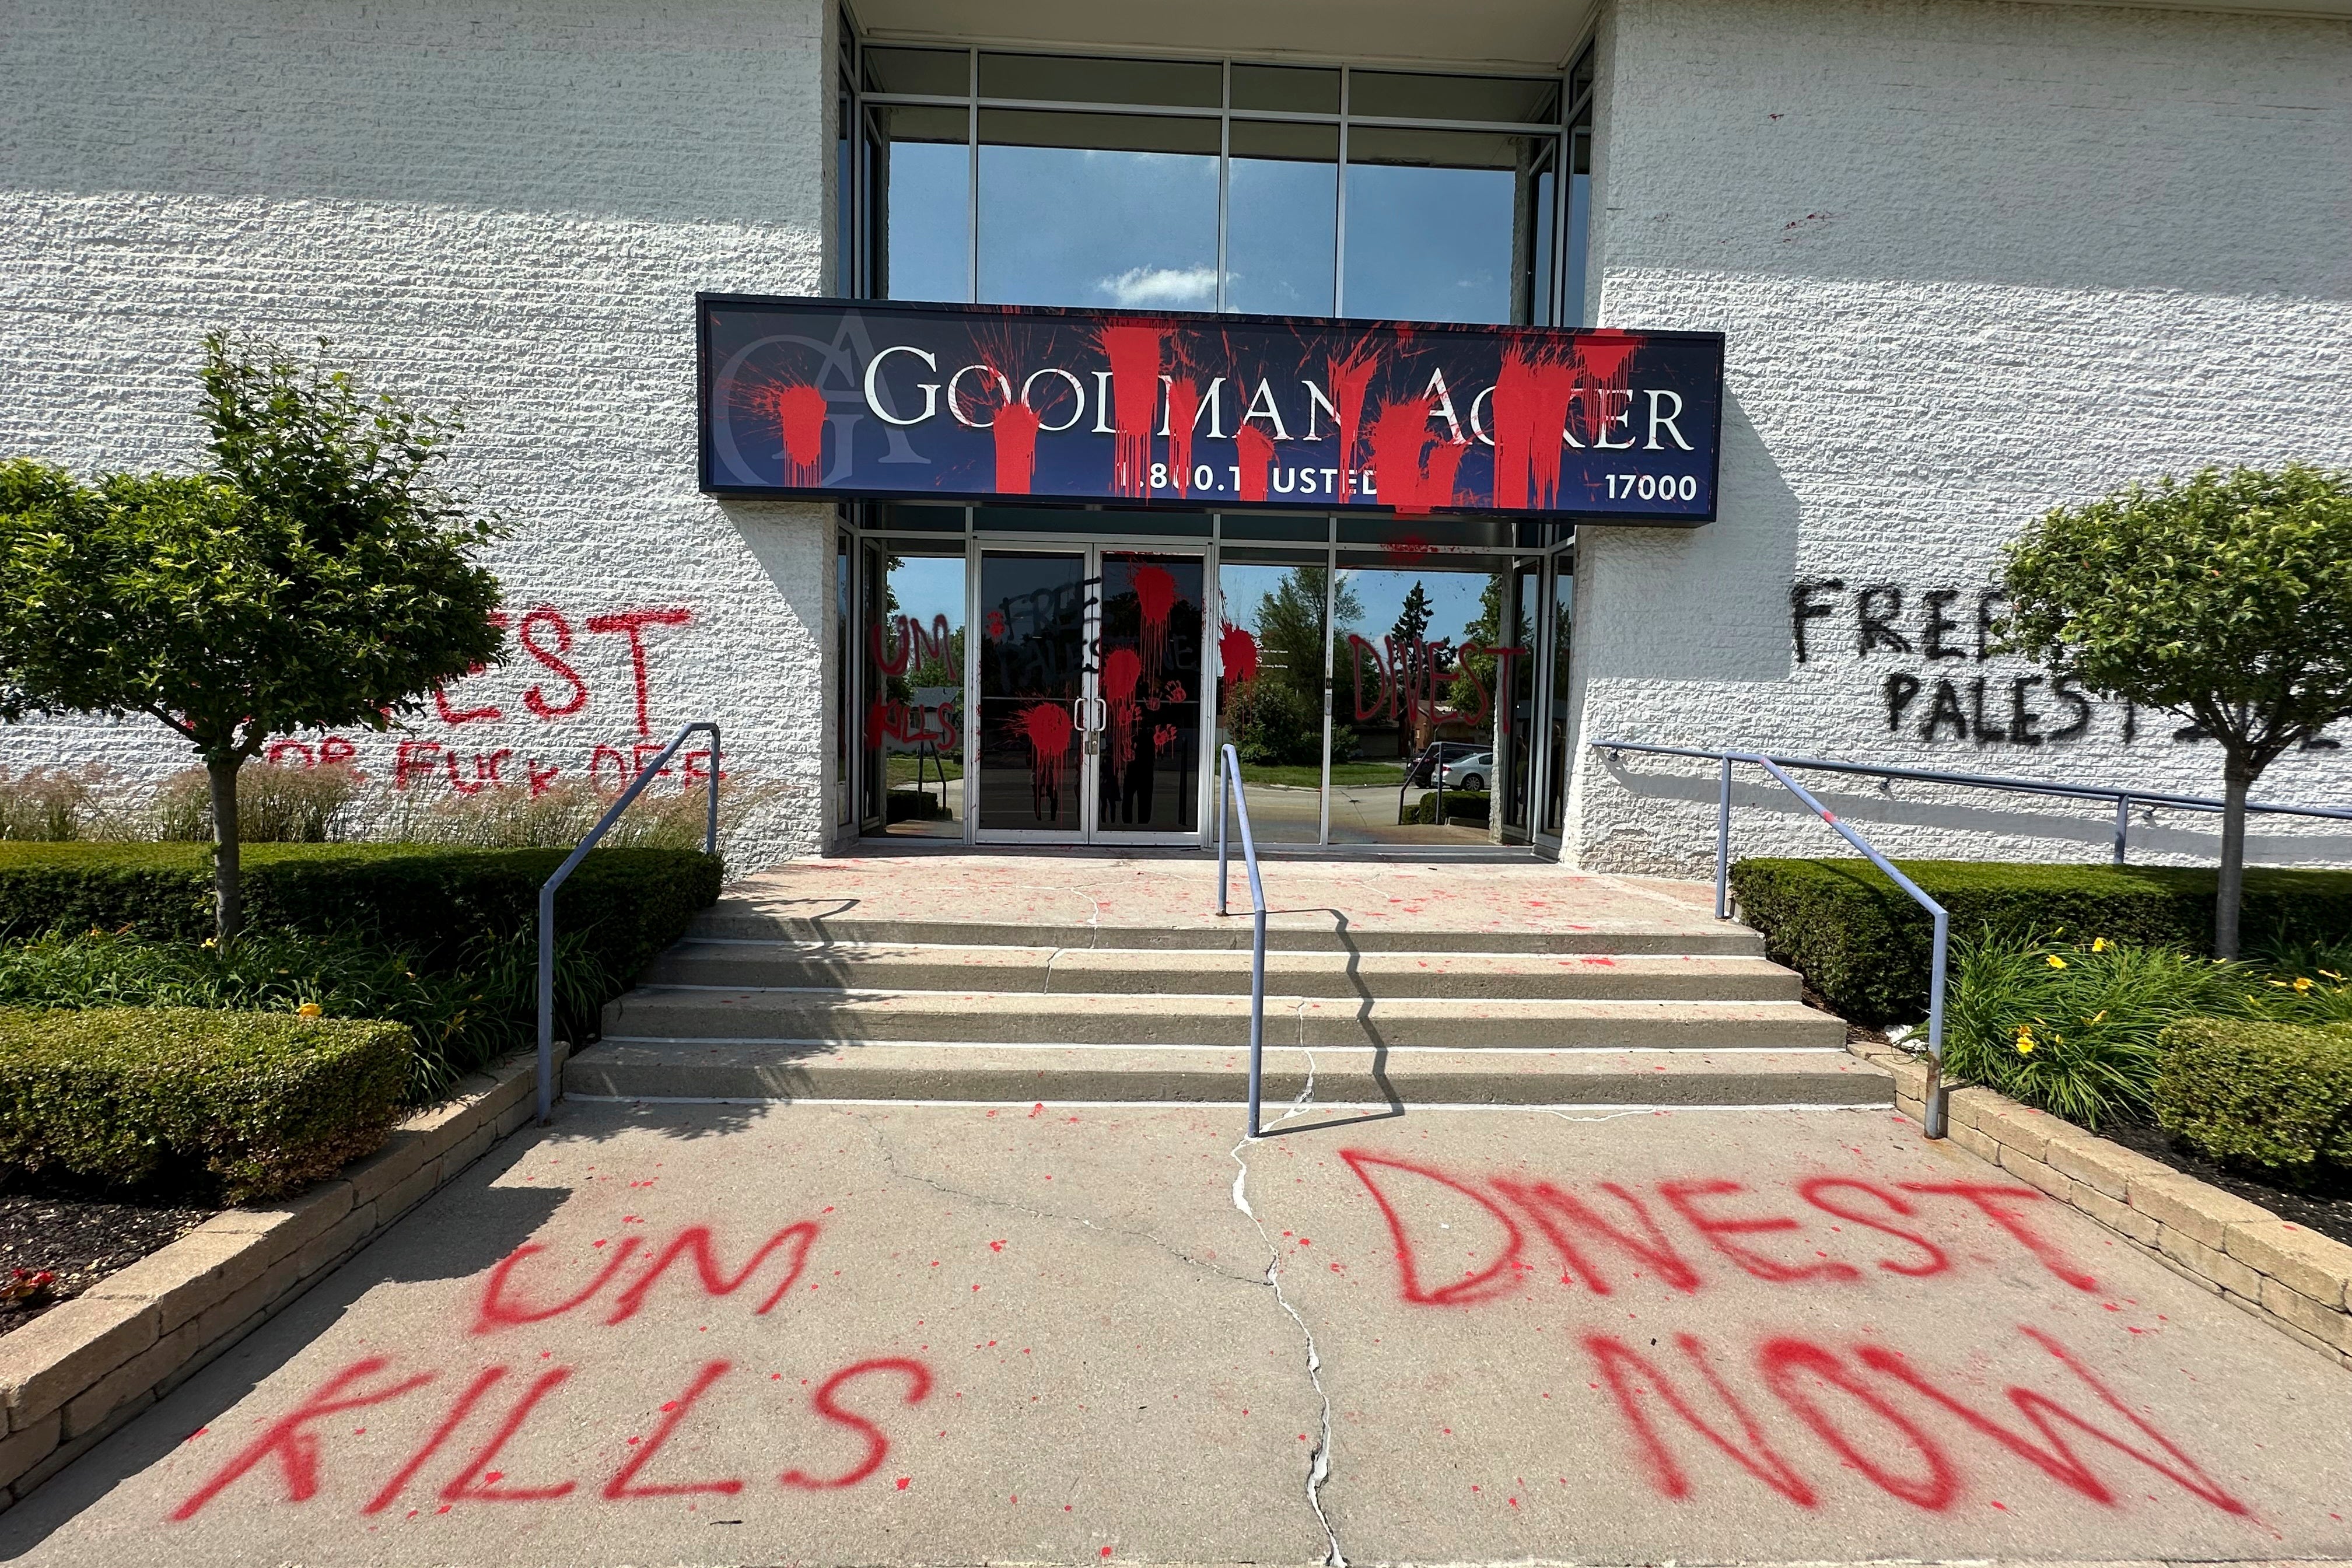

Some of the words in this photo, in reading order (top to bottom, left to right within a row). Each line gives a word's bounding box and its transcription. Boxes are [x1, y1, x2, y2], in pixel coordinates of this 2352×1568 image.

[1116, 462, 1378, 495] 1.800.TUSTED
[1605, 474, 1696, 501] 17000
[872, 612, 957, 680] UM
[1348, 632, 1527, 734] DIVEST
[1884, 670, 2342, 751] PALES
[470, 1220, 820, 1335] UM
[1338, 1147, 2104, 1307] DIVEST
[170, 1354, 933, 1521] KILLS
[1582, 1323, 2258, 1517] NOW
